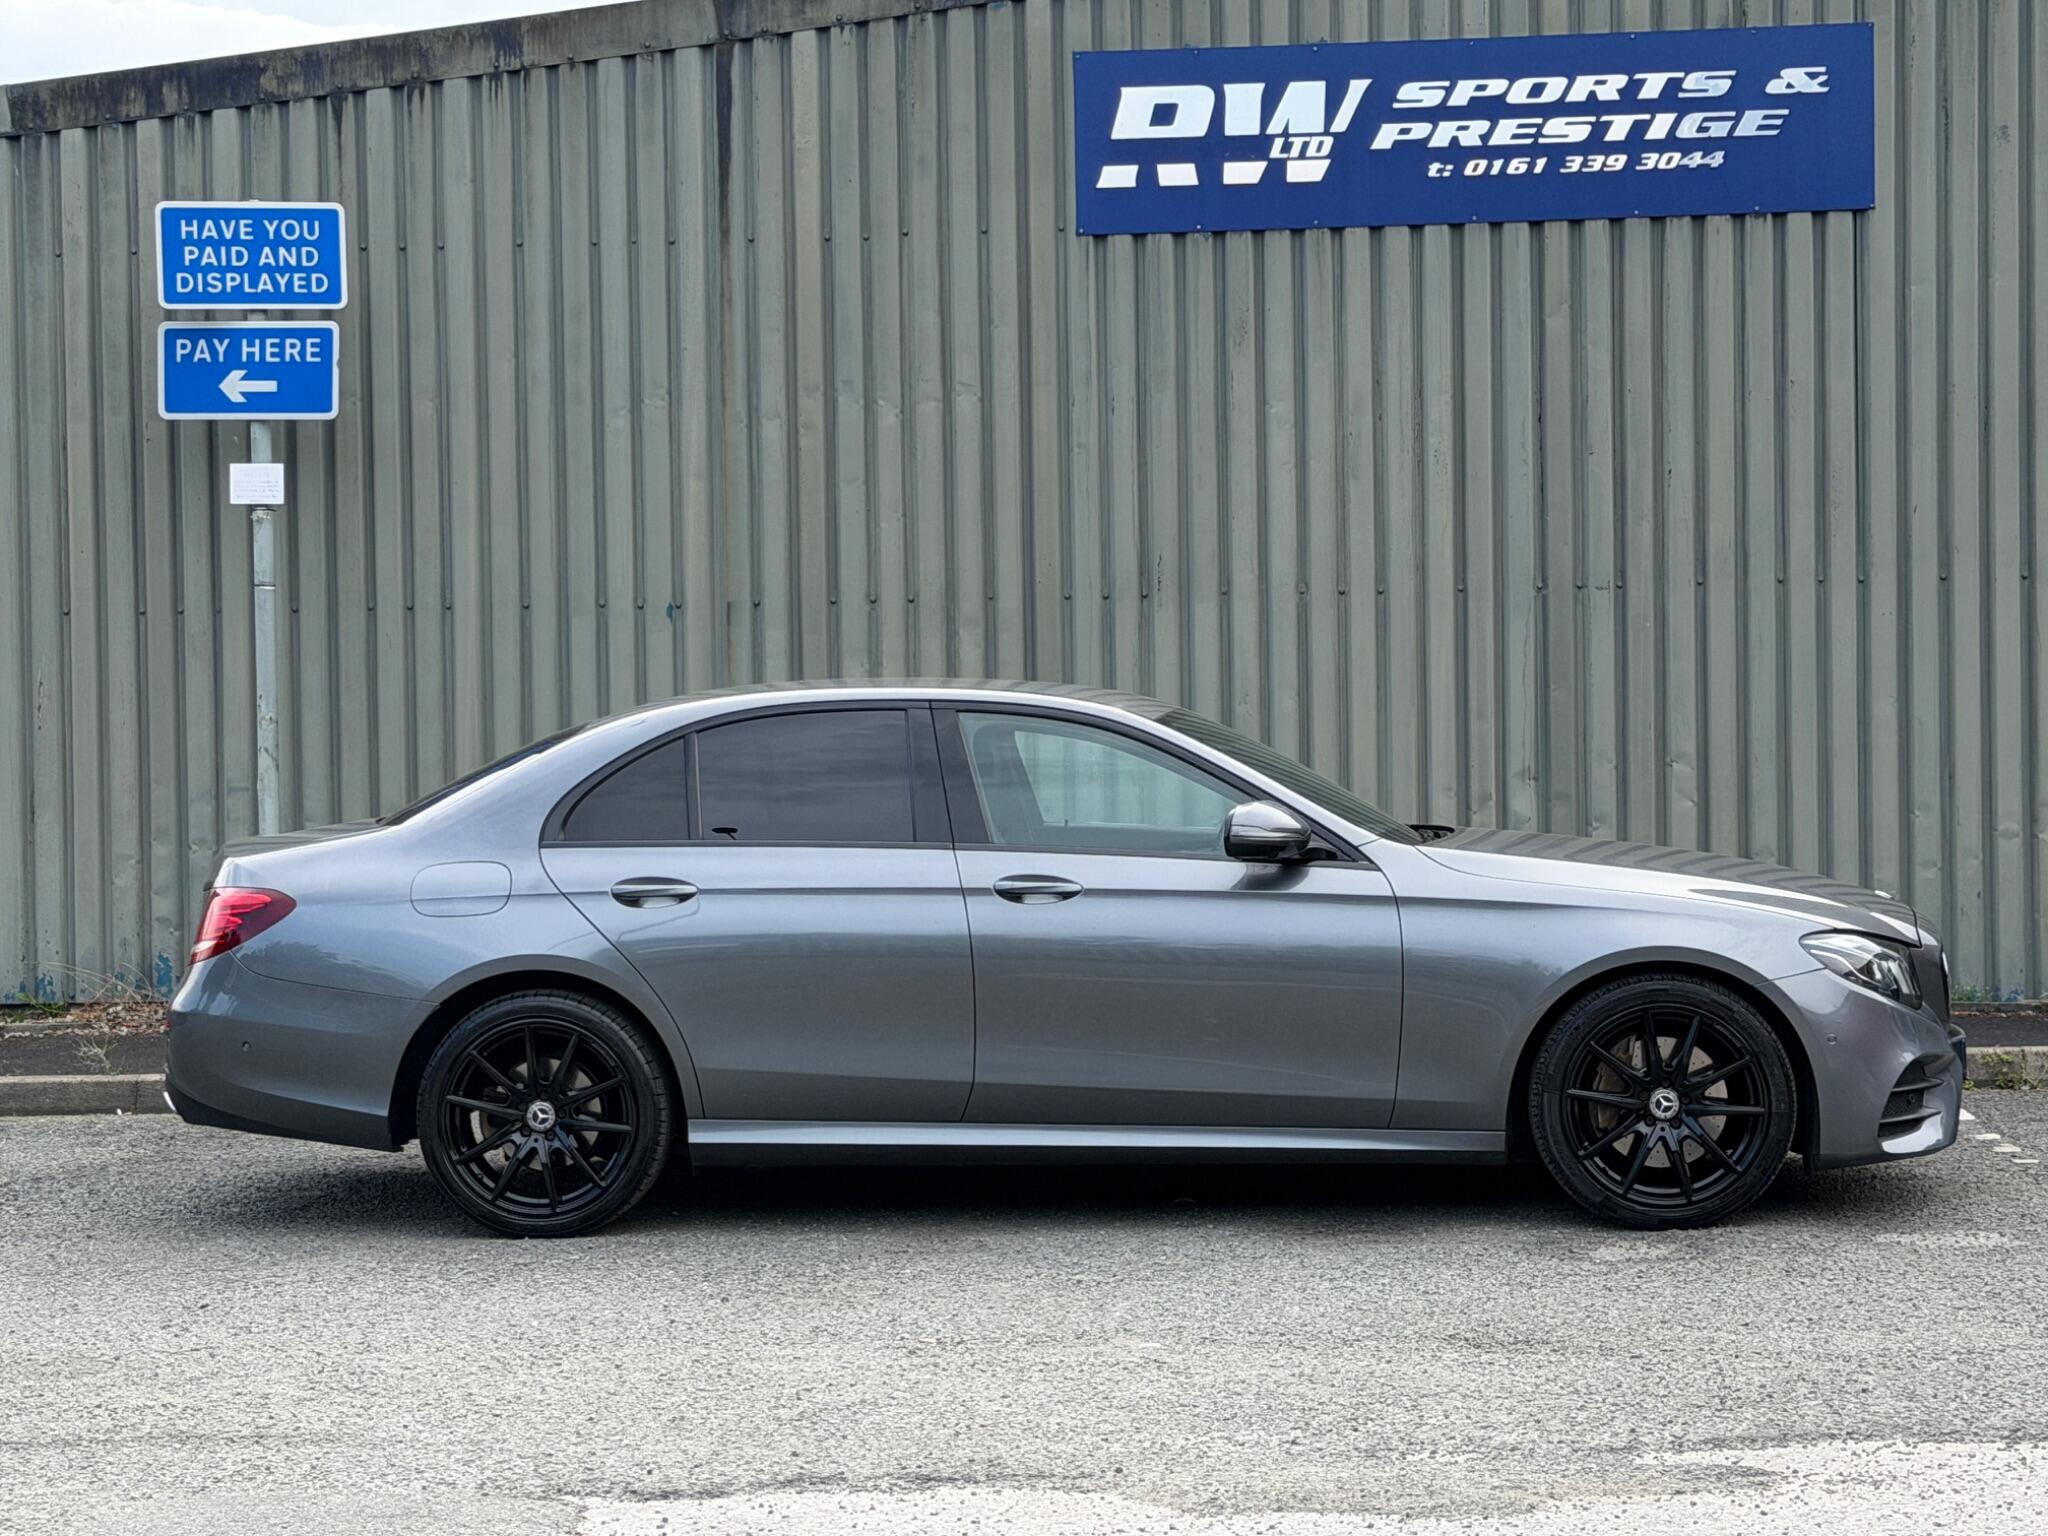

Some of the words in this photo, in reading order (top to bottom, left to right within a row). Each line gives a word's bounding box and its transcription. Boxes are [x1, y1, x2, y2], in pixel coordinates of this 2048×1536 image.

[1392, 71, 1737, 108] SPORTS
[1765, 66, 1830, 94] &
[1369, 109, 1790, 150] PRESTIGE
[1268, 136, 1334, 158] LTD
[1427, 162, 1454, 177] t:
[1463, 157, 1548, 176] 0161
[1559, 154, 1628, 173] 339
[1635, 151, 1725, 171] 3044
[181, 219, 254, 240] HAVE
[263, 219, 320, 240] YOU
[184, 246, 249, 267] PAID
[259, 246, 319, 267] AND
[176, 272, 329, 294] DISPLAYED
[175, 338, 230, 363] PAY
[241, 338, 321, 363] HERE
